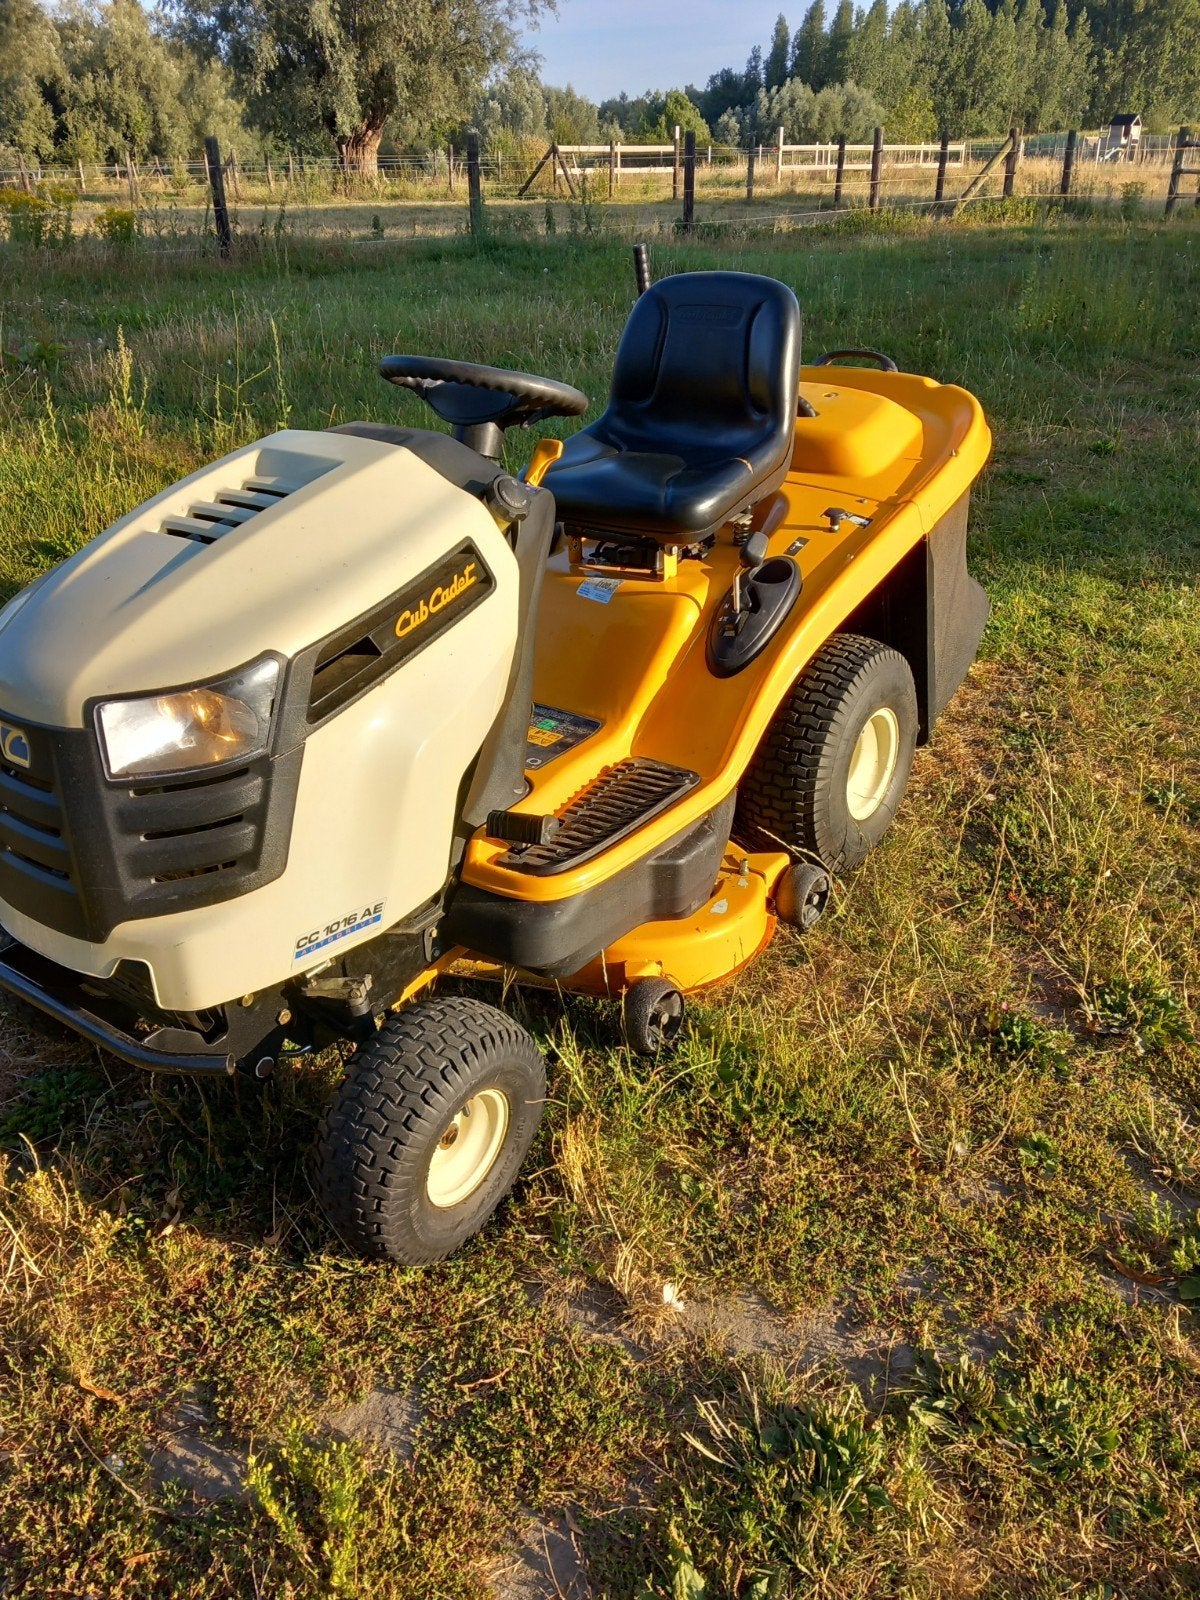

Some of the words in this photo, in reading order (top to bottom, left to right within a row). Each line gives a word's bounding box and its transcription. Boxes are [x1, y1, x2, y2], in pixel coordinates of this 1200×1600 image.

[395, 600, 429, 637] Cub
[428, 562, 477, 613] Cadet
[296, 930, 320, 949] CC
[323, 912, 358, 936] 1016
[360, 902, 384, 920] AE
[301, 915, 375, 955] AUTODRIVE
